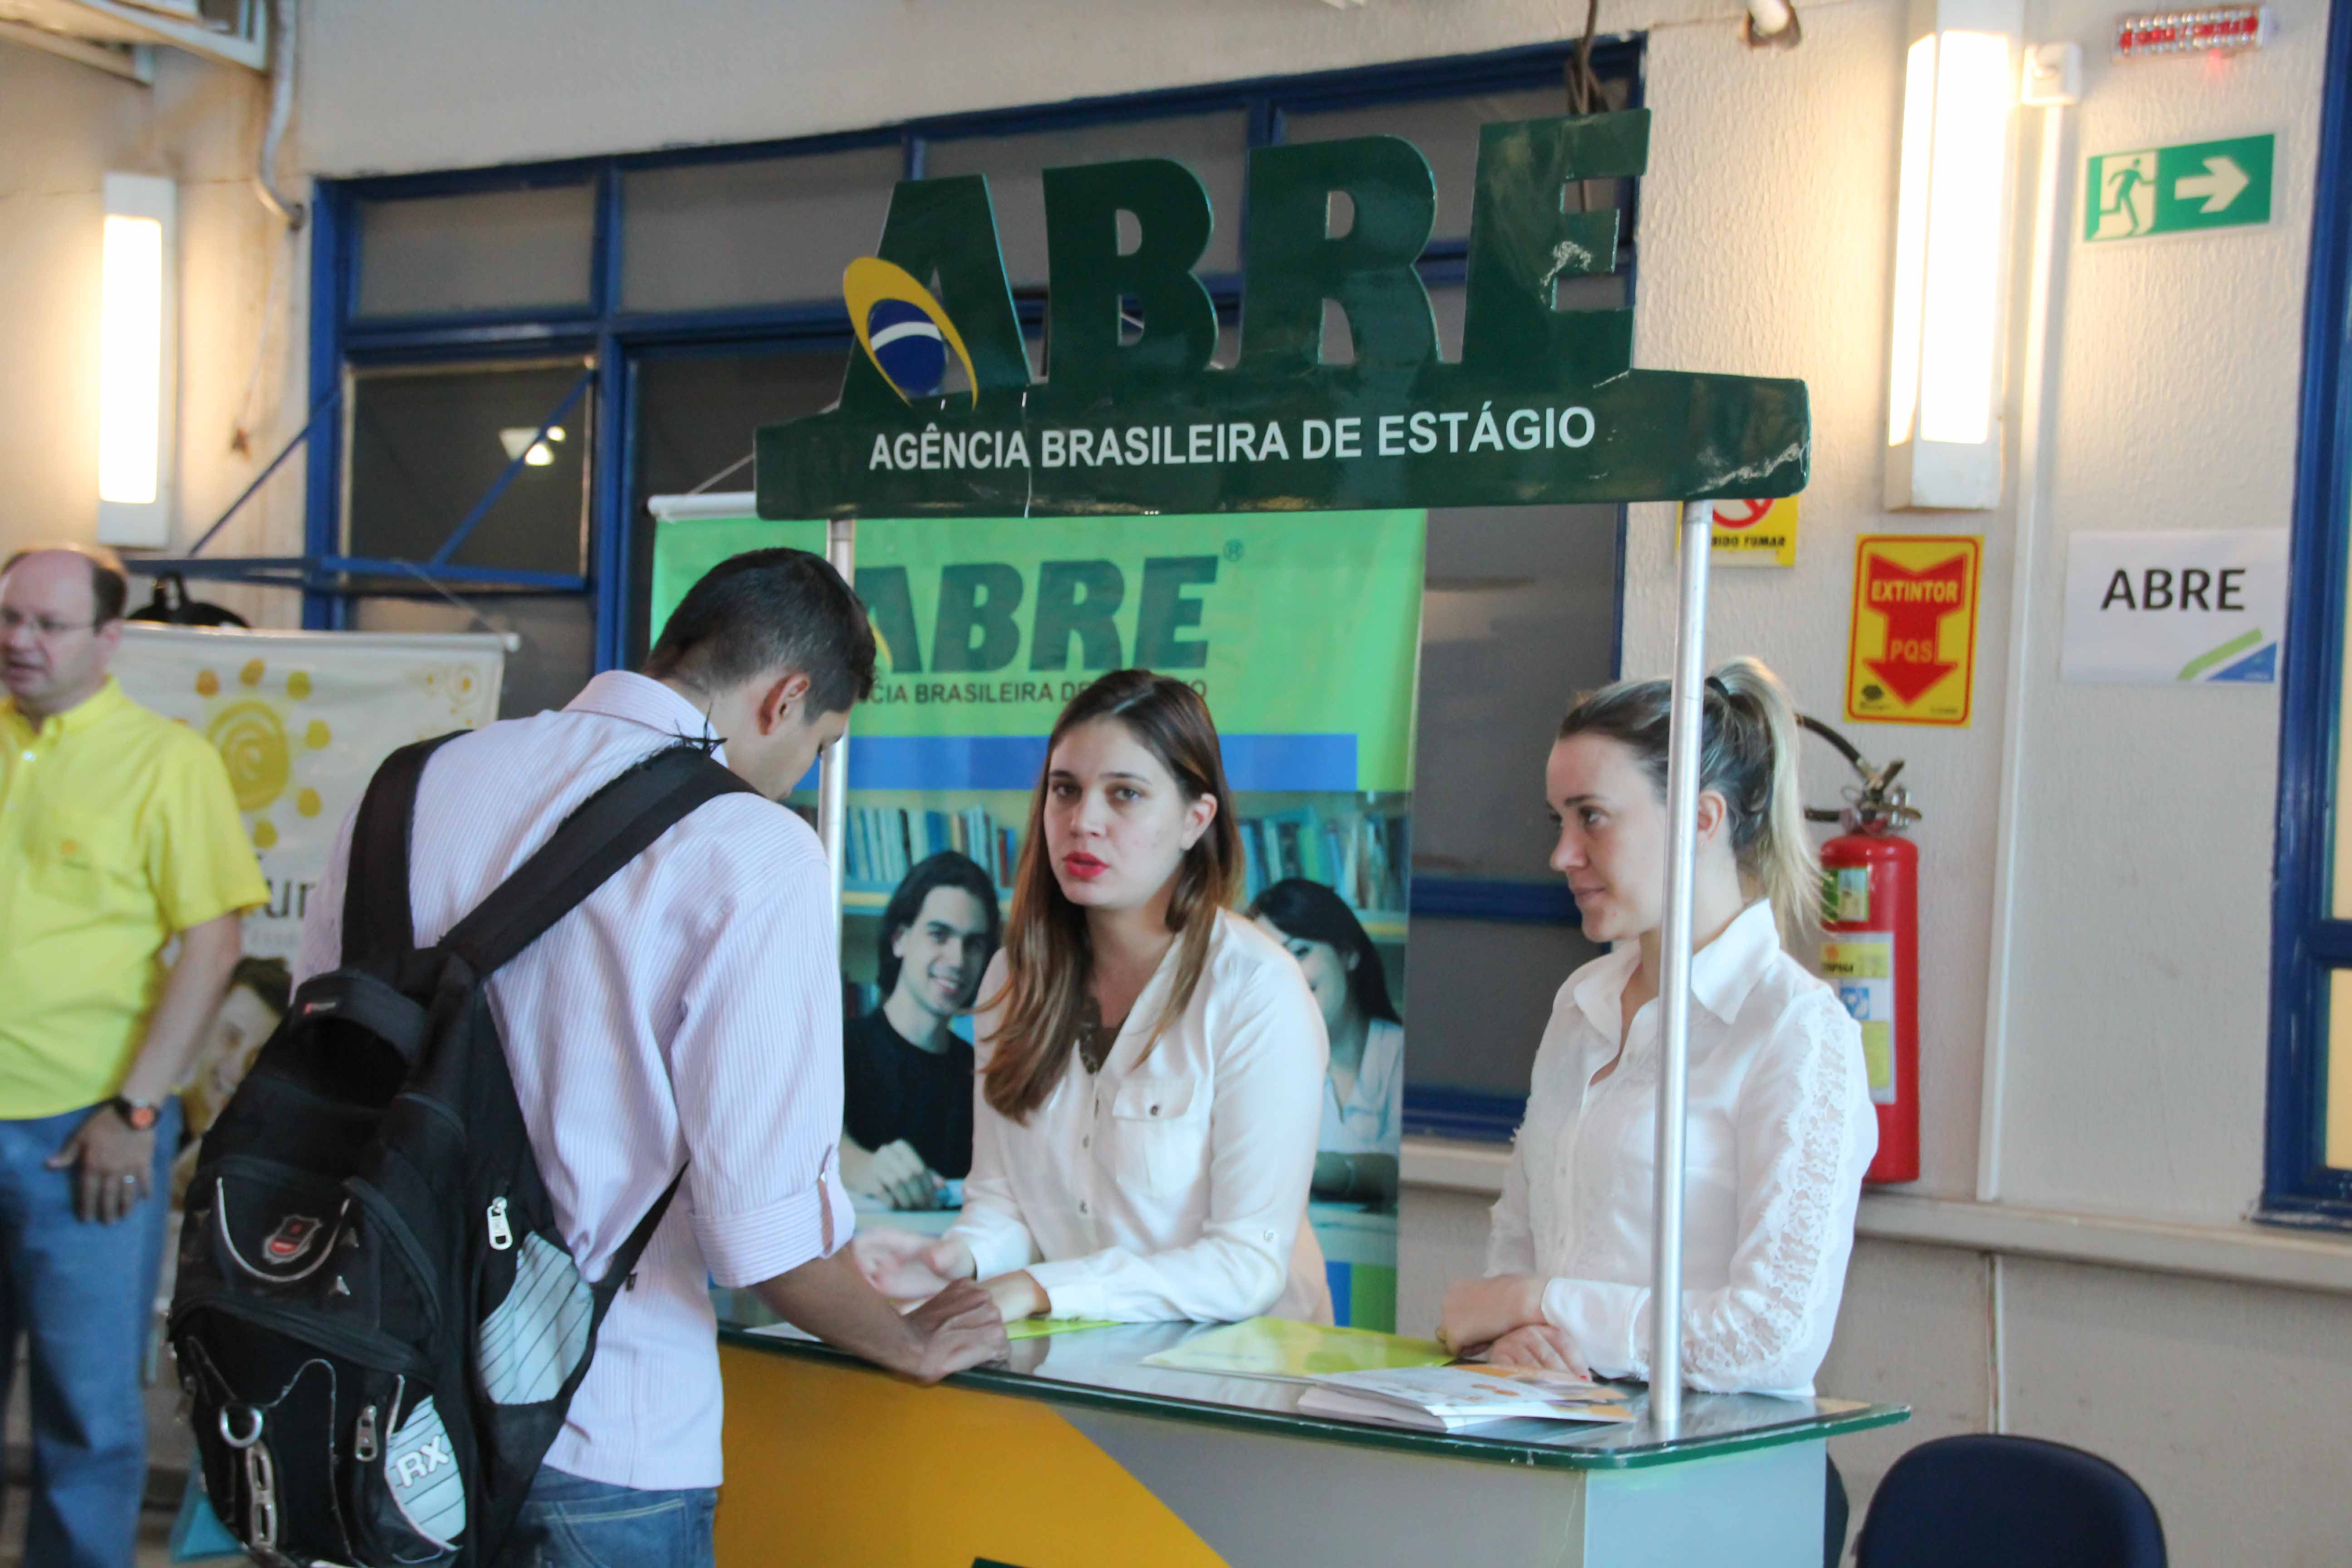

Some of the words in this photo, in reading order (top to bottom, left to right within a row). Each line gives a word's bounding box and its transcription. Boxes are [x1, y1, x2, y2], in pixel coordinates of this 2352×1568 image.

[838, 109, 1651, 408] ABRE
[869, 423, 1030, 470] AGÊNCIA
[1041, 421, 1289, 467] BRASILEIRA
[1303, 417, 1361, 459] DE
[1379, 401, 1595, 456] ESTÁGIO
[1871, 580, 1959, 603] EXTINTOR
[2100, 568, 2246, 611] ABRE
[855, 556, 1219, 673] ABRE
[1890, 640, 1933, 663] PQS
[870, 683, 909, 703] CIA
[916, 681, 1053, 704] BRASILEIRA
[396, 1435, 448, 1487] RX
